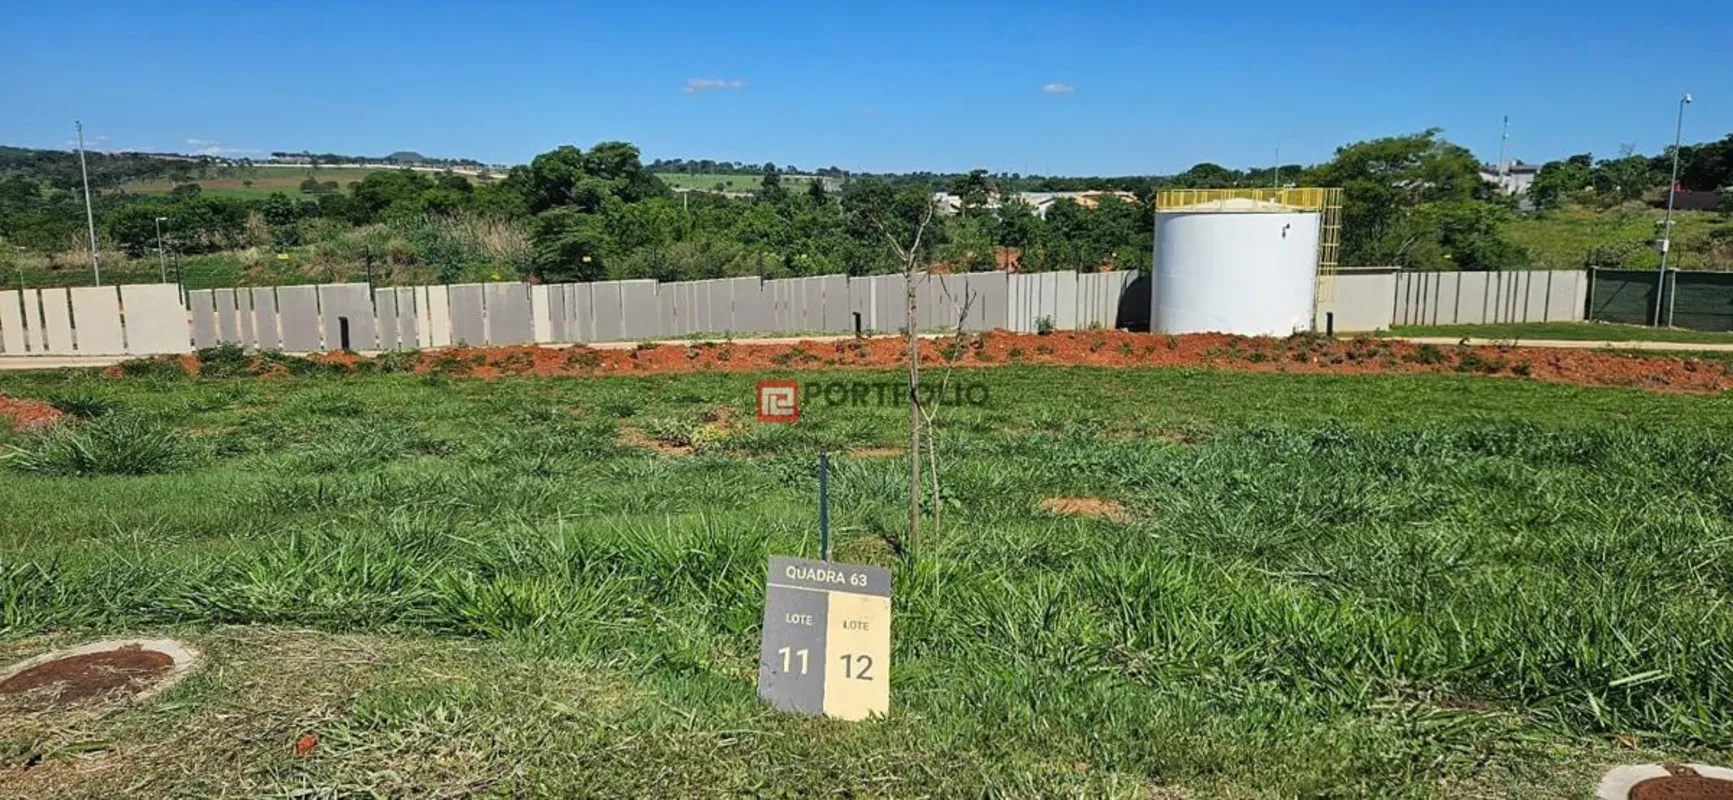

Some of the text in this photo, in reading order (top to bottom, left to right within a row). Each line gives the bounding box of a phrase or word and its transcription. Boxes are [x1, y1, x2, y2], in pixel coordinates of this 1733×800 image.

[786, 565, 868, 587] QUADRA 63
[785, 613, 813, 626] LOTE
[843, 620, 870, 631] LOTE
[778, 646, 809, 675] 11
[840, 653, 874, 681] 12
